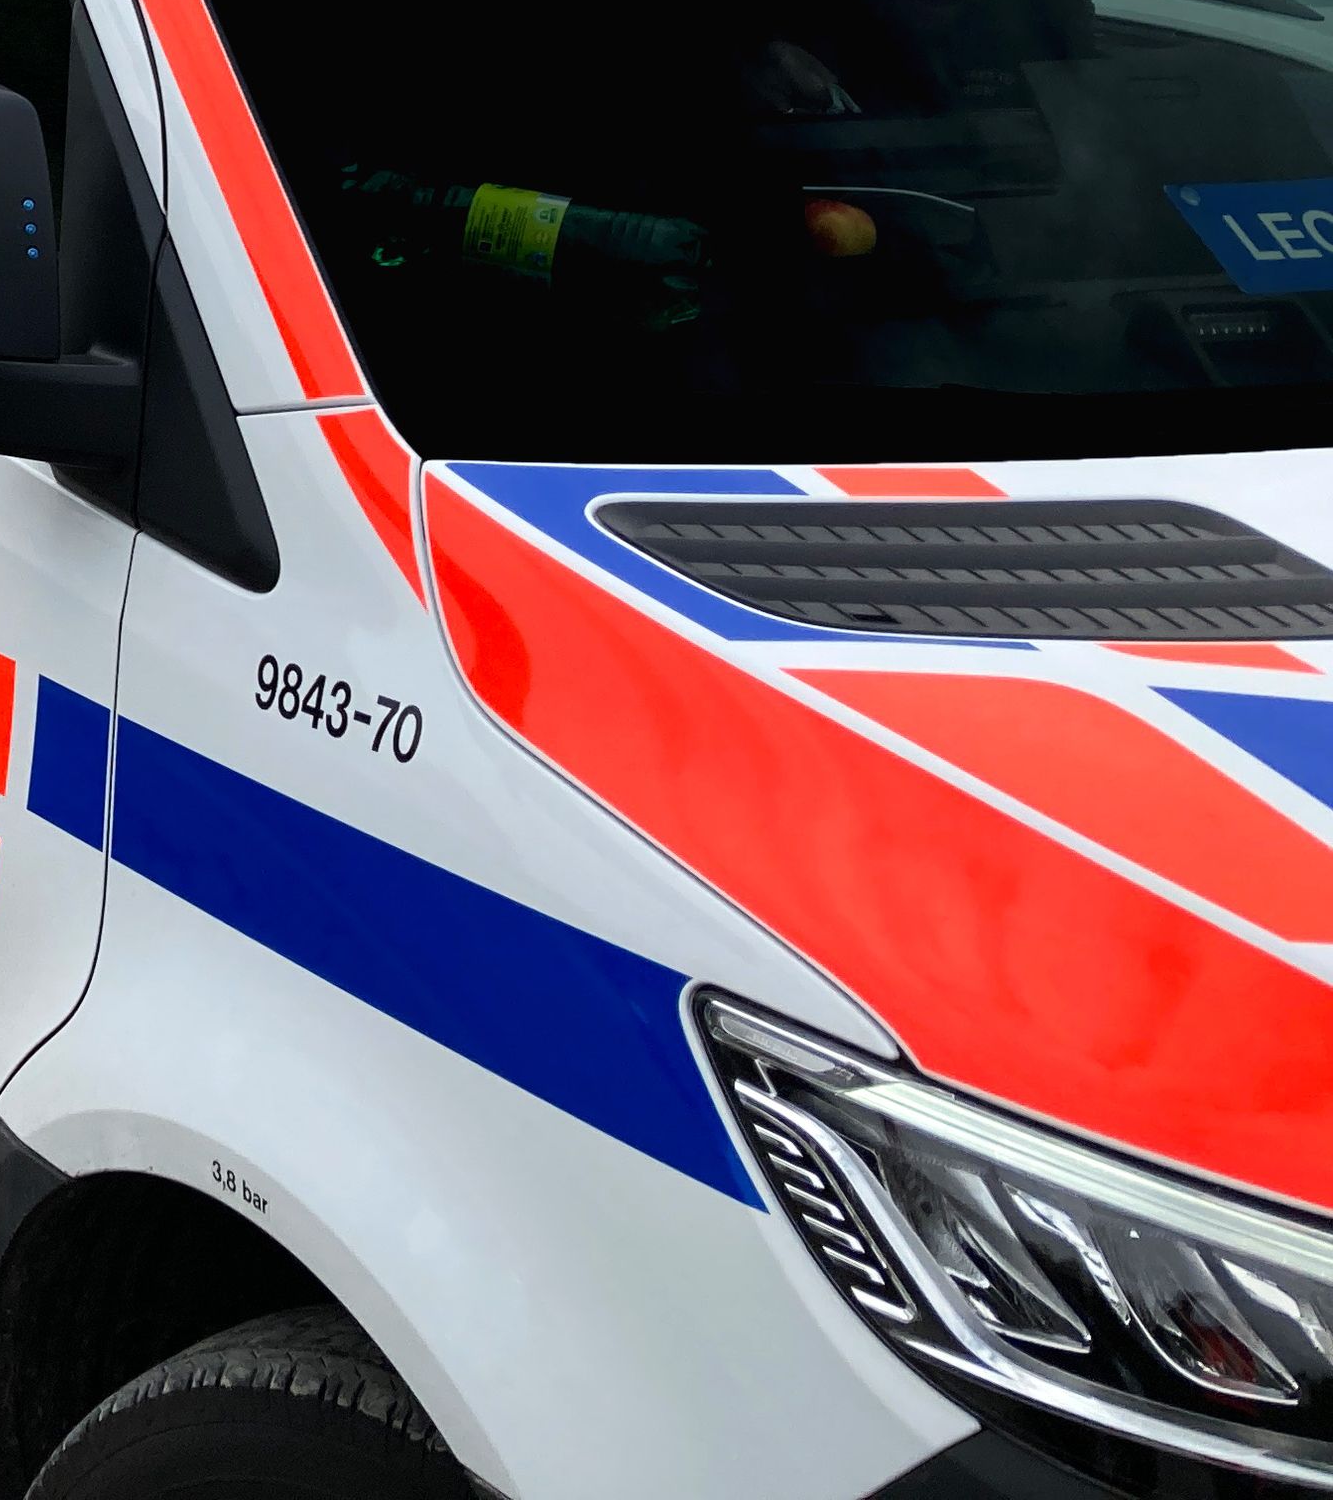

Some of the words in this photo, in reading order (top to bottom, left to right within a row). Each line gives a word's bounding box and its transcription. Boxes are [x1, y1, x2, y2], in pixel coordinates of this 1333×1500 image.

[255, 654, 423, 763] 9843-70
[213, 1160, 237, 1192] 3,8
[242, 1179, 268, 1214] bar
